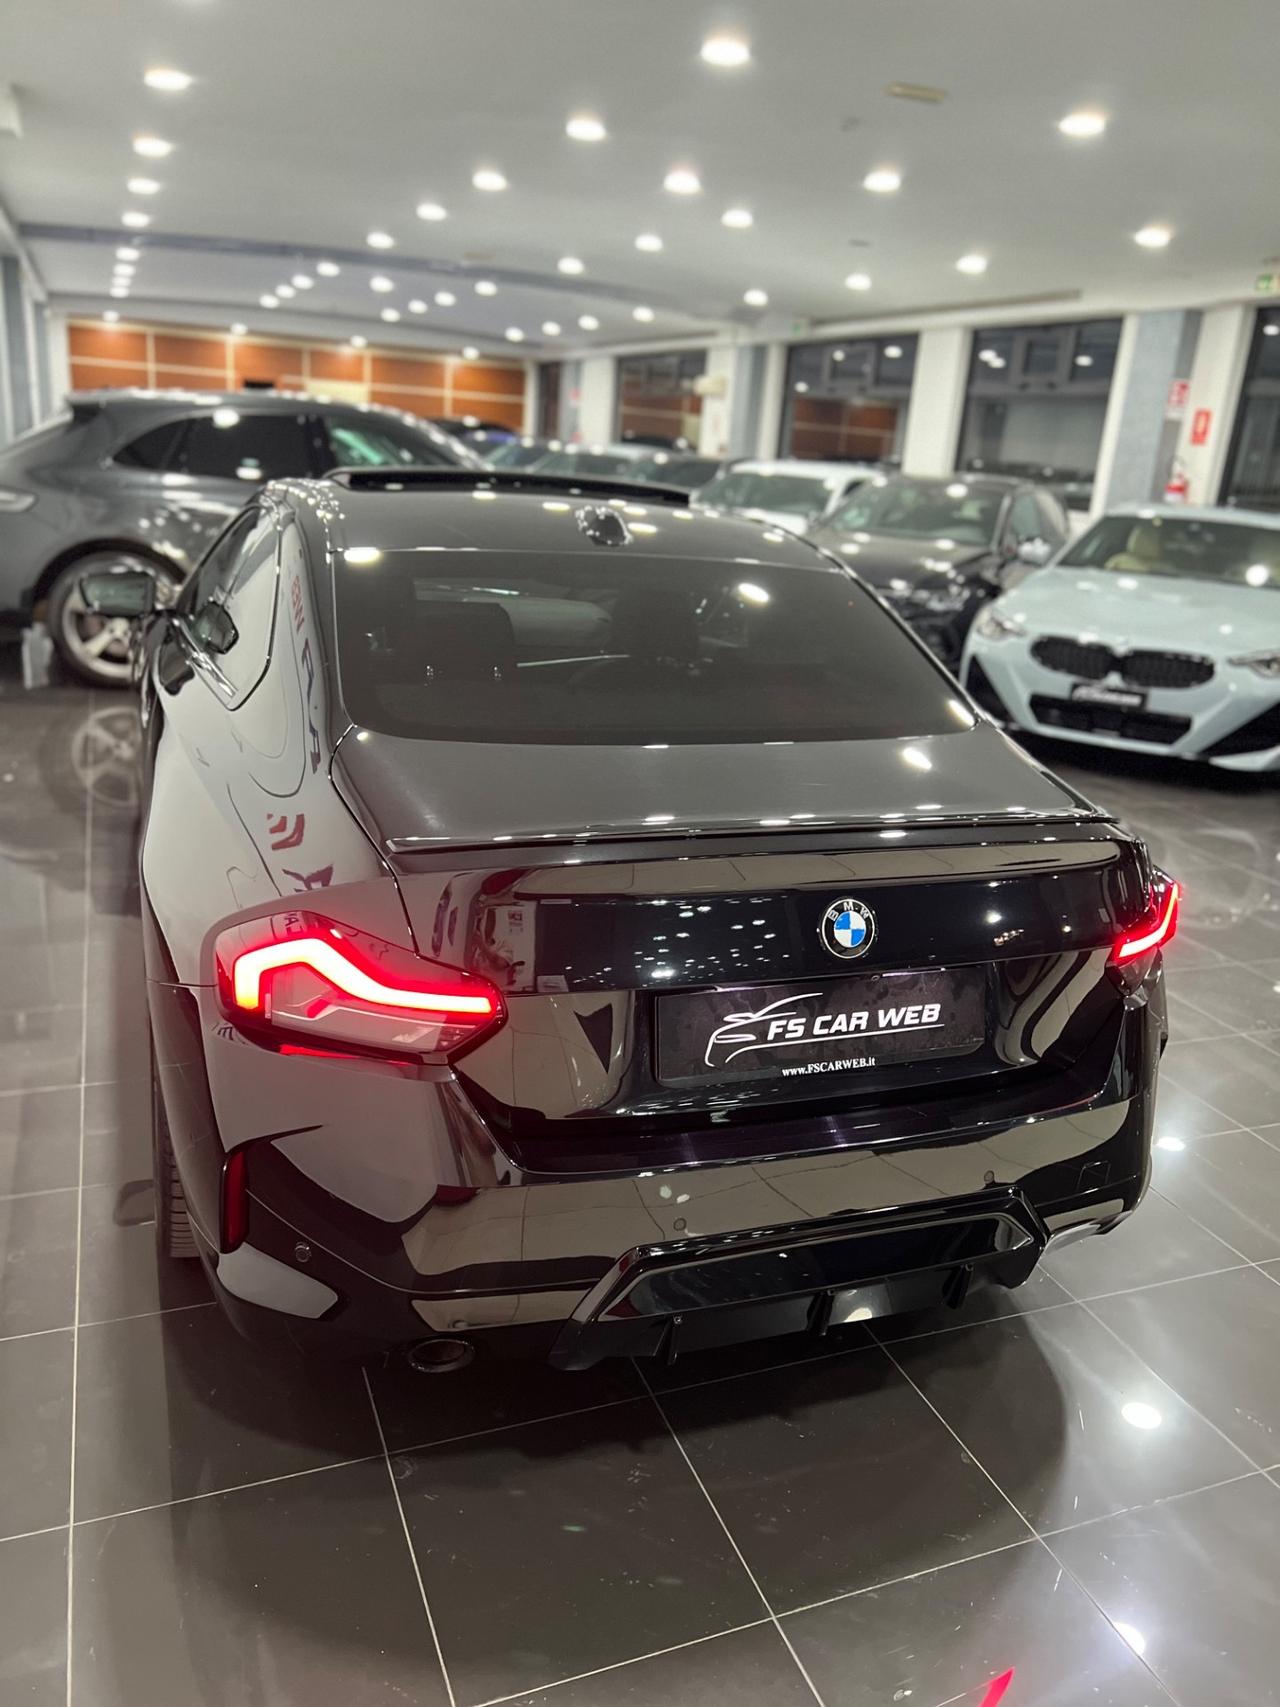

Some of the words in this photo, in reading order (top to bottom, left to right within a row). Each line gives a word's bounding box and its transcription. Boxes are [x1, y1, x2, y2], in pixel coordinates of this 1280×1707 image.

[827, 901, 869, 921] BMW
[767, 1017, 806, 1041] FS
[812, 1011, 869, 1036] CAR
[877, 1003, 942, 1028] WEB
[782, 1057, 876, 1077] www.FSCARWEB.it
